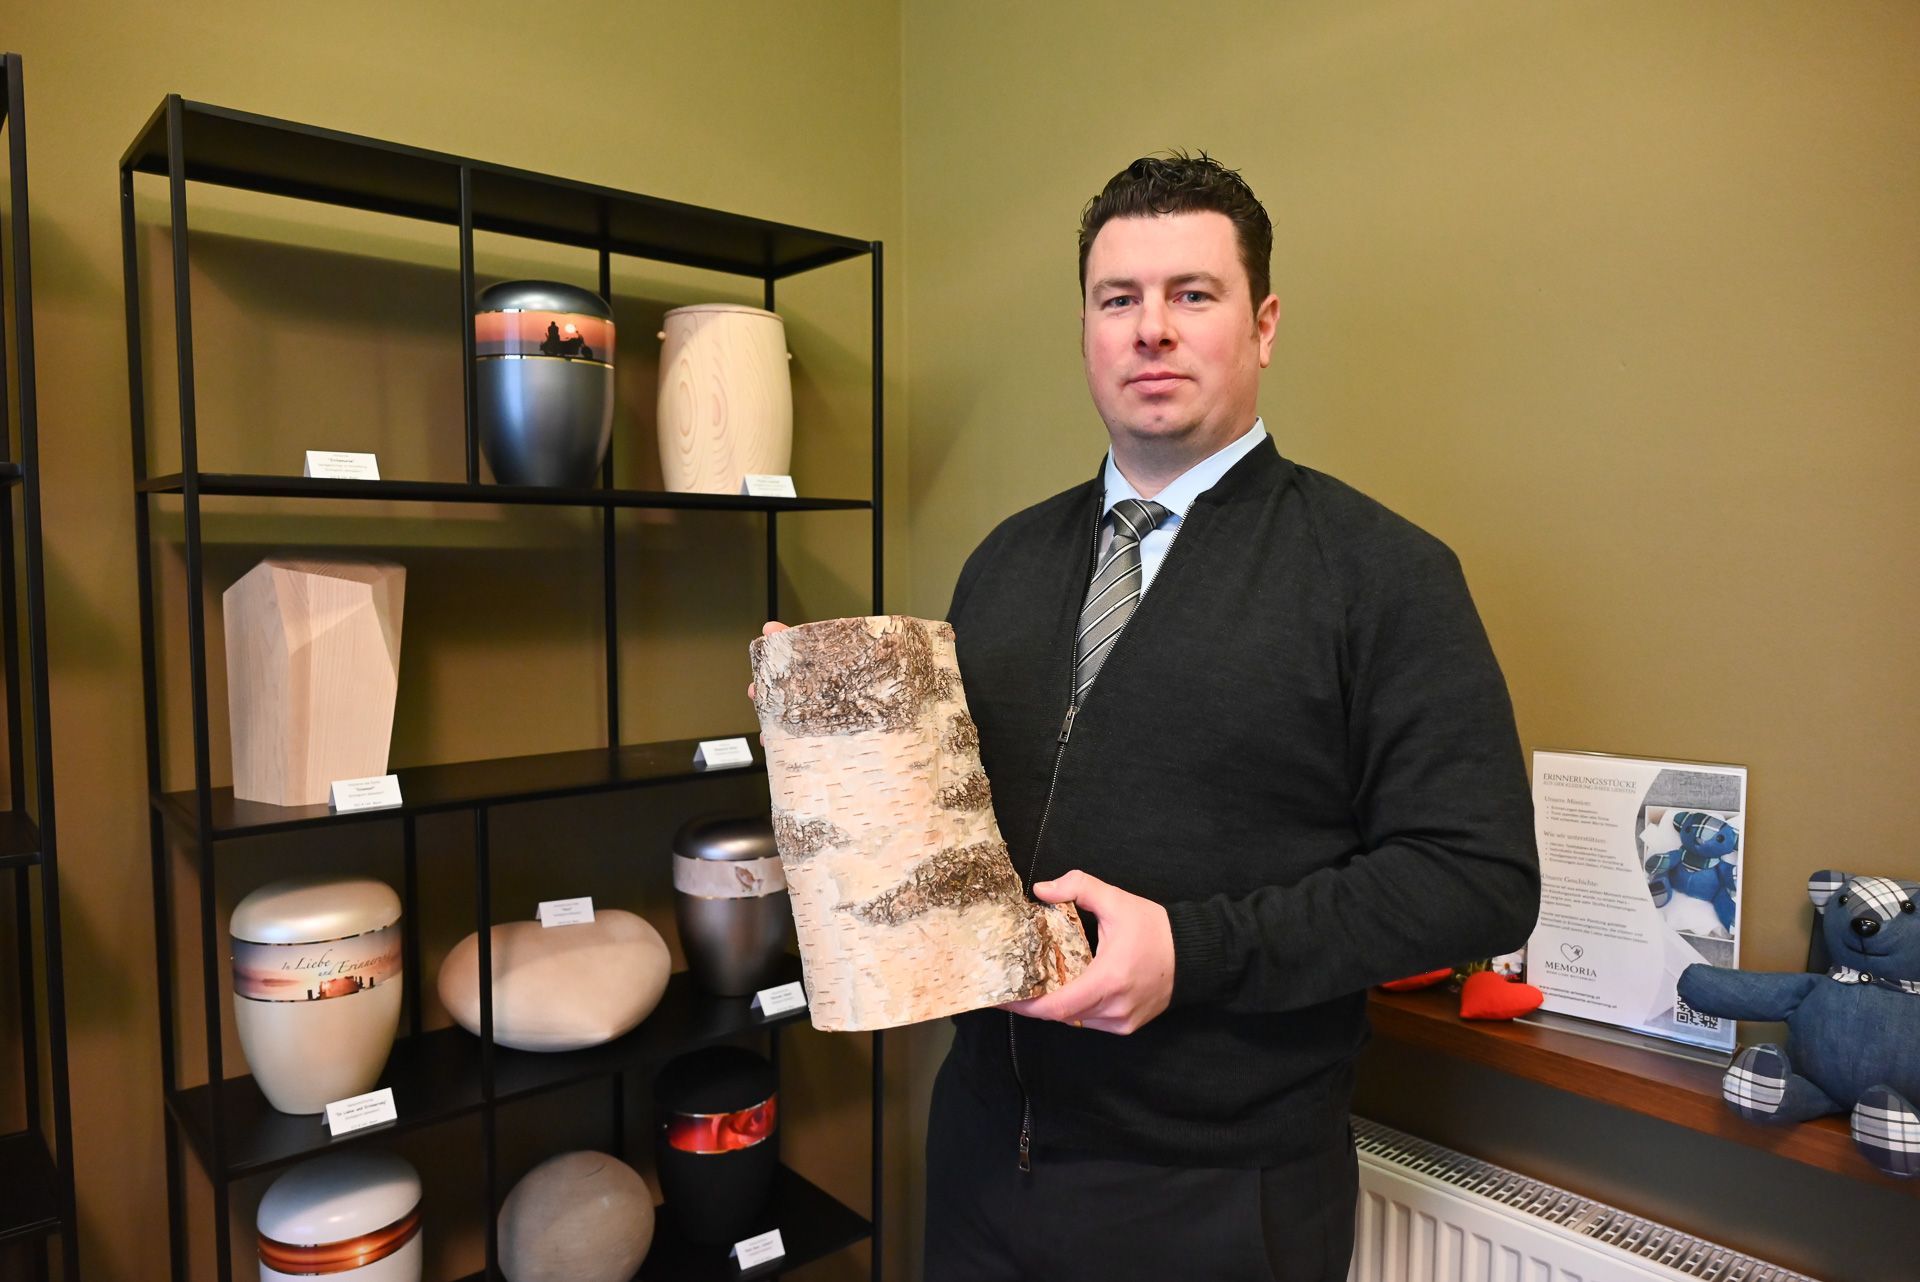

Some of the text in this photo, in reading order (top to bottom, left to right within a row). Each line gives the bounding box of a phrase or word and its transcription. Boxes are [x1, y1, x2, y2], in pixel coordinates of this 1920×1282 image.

[1543, 773, 1637, 789] ERINNERUNGSSTÜCKE
[295, 948, 333, 970] Liebe
[1545, 961, 1598, 977] MEMORIA
